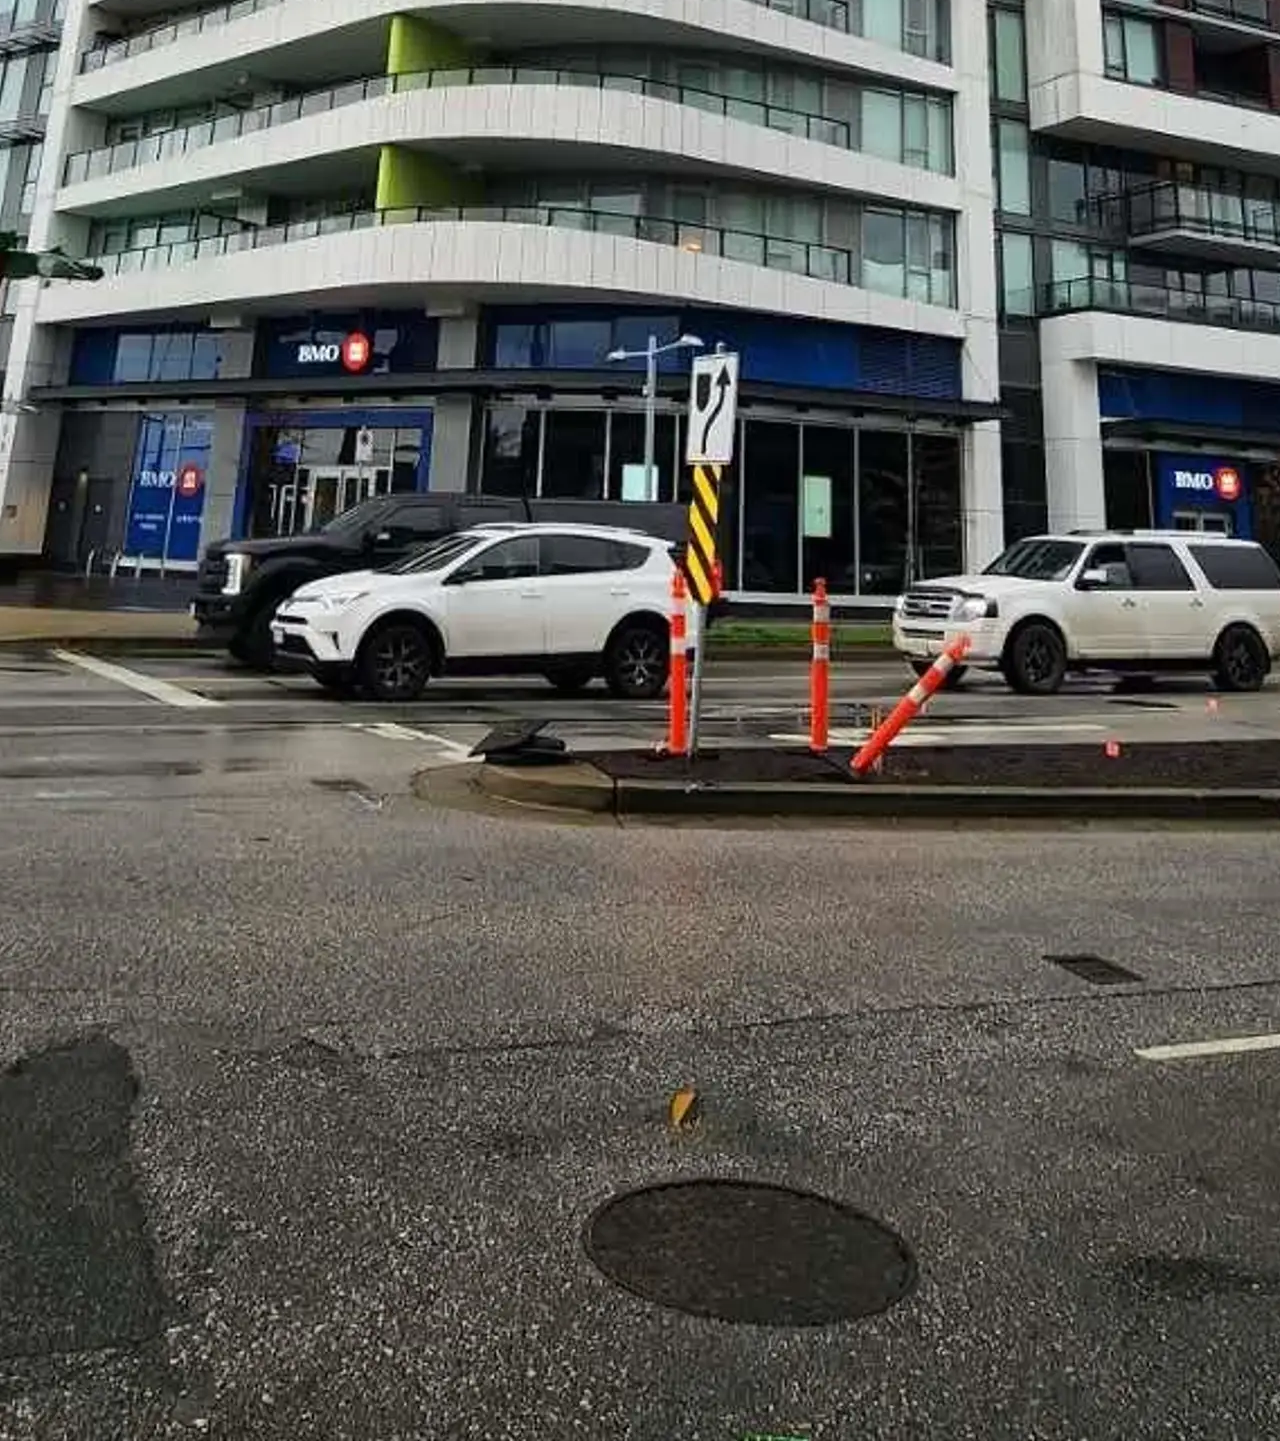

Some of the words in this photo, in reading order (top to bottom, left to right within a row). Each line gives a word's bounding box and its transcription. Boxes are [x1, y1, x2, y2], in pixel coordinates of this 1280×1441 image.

[298, 344, 340, 363] BMO
[140, 470, 177, 488] BMO
[1174, 470, 1214, 490] BMO
